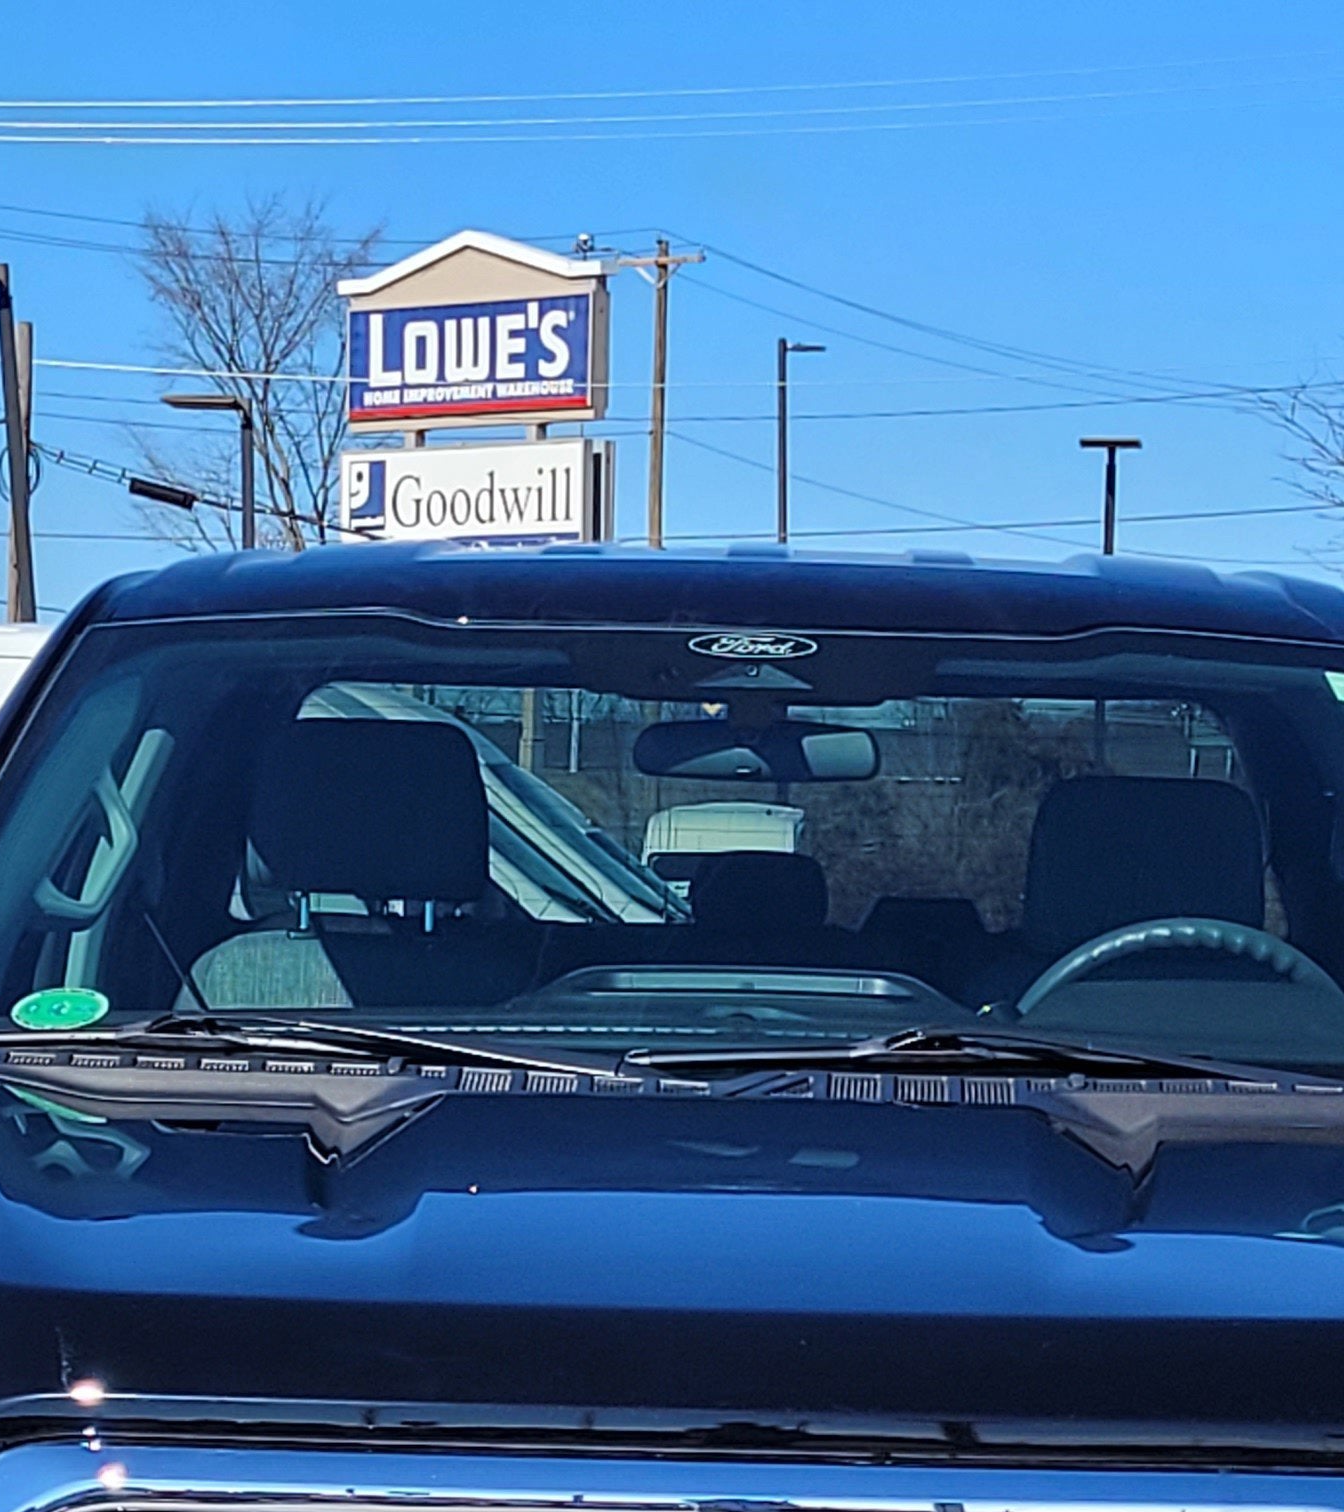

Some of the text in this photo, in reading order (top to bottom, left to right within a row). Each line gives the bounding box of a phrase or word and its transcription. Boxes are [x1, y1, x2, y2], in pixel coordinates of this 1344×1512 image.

[368, 301, 570, 388] LOWE'S
[391, 466, 573, 528] Goodwill
[711, 636, 795, 655] Ford
